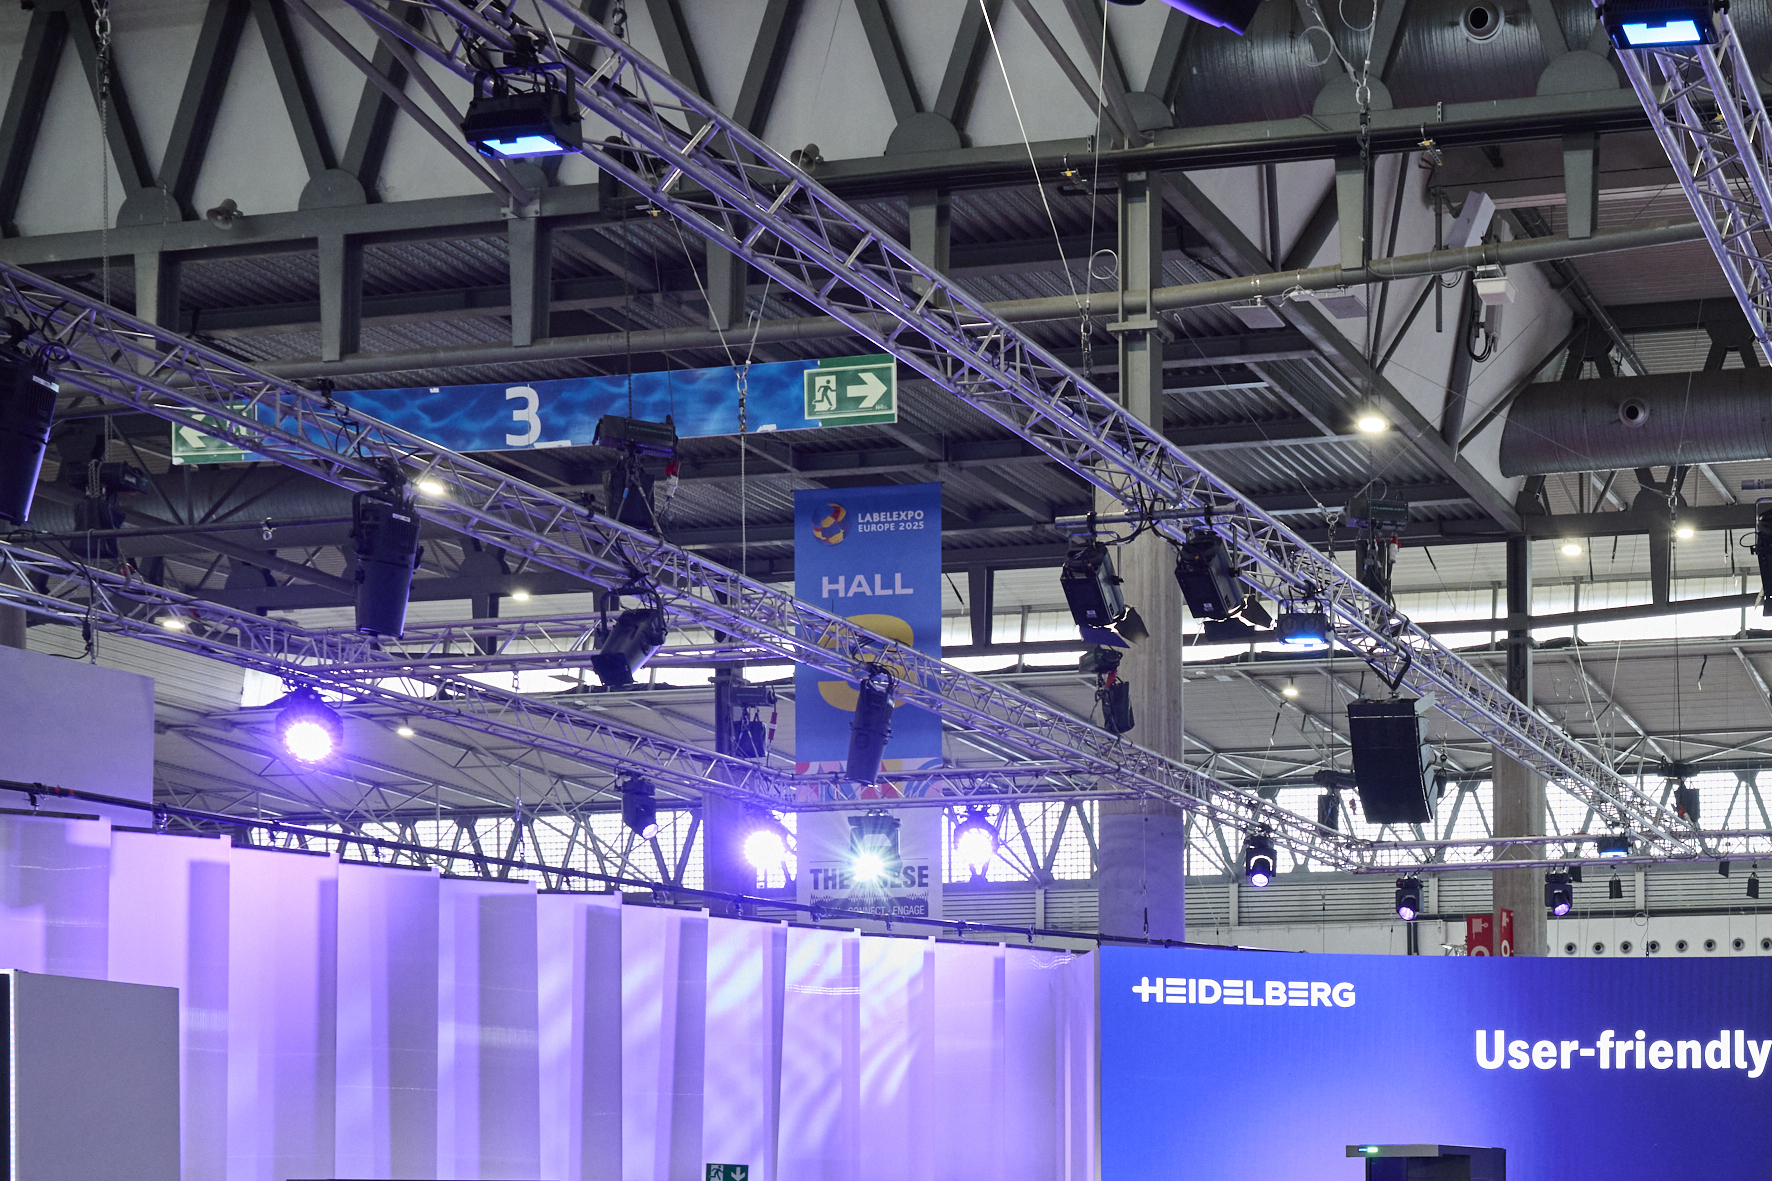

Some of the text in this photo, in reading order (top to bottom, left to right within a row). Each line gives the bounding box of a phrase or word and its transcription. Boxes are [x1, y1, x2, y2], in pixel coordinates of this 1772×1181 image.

[505, 387, 542, 447] 3
[857, 510, 925, 524] LABELEXPO
[857, 520, 925, 533] EUROPE 2025
[821, 573, 914, 599] HALL
[892, 904, 925, 916] ENGAGE
[1131, 976, 1356, 1008] HEIDELBERG
